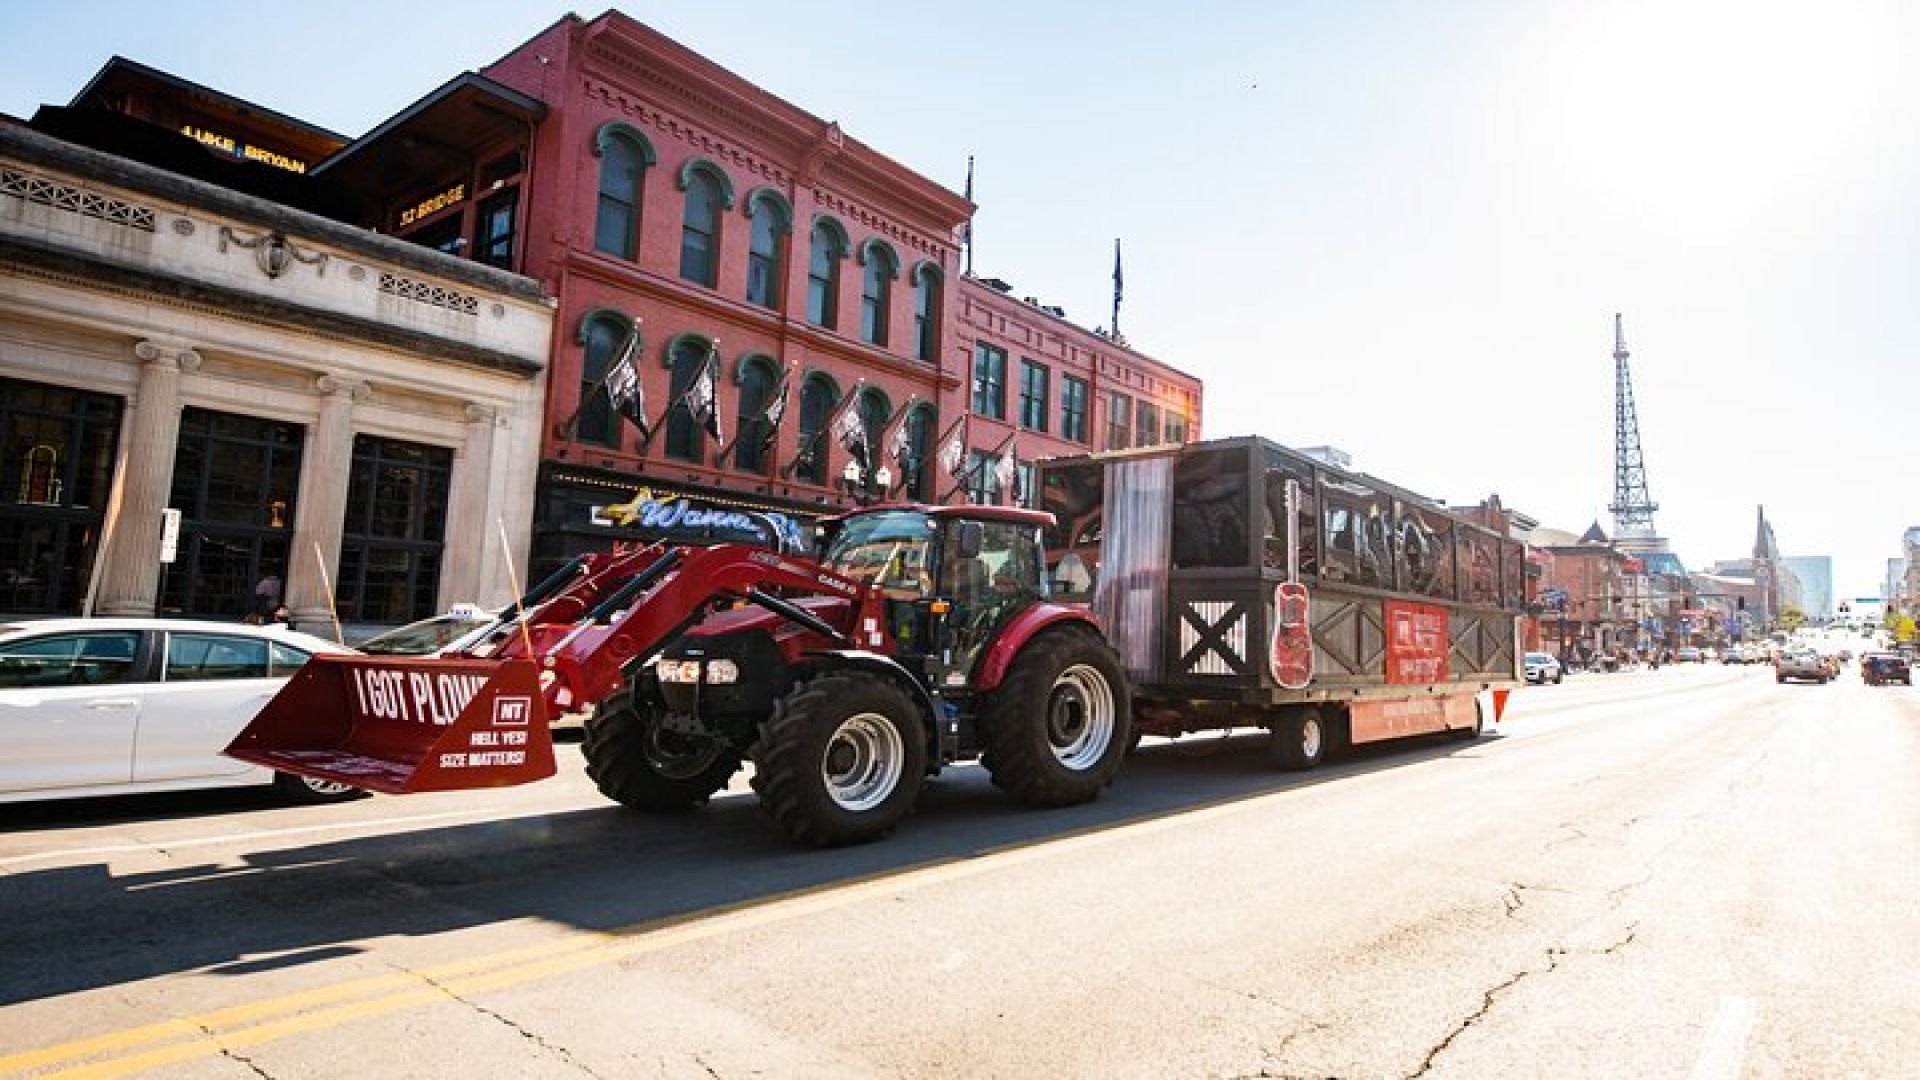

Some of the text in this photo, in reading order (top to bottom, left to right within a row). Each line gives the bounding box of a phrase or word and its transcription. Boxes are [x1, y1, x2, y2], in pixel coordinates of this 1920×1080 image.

[181, 125, 305, 174] LUKE BRYAN
[418, 184, 465, 219] BRIDGE
[354, 668, 490, 725] I GOT PLOW
